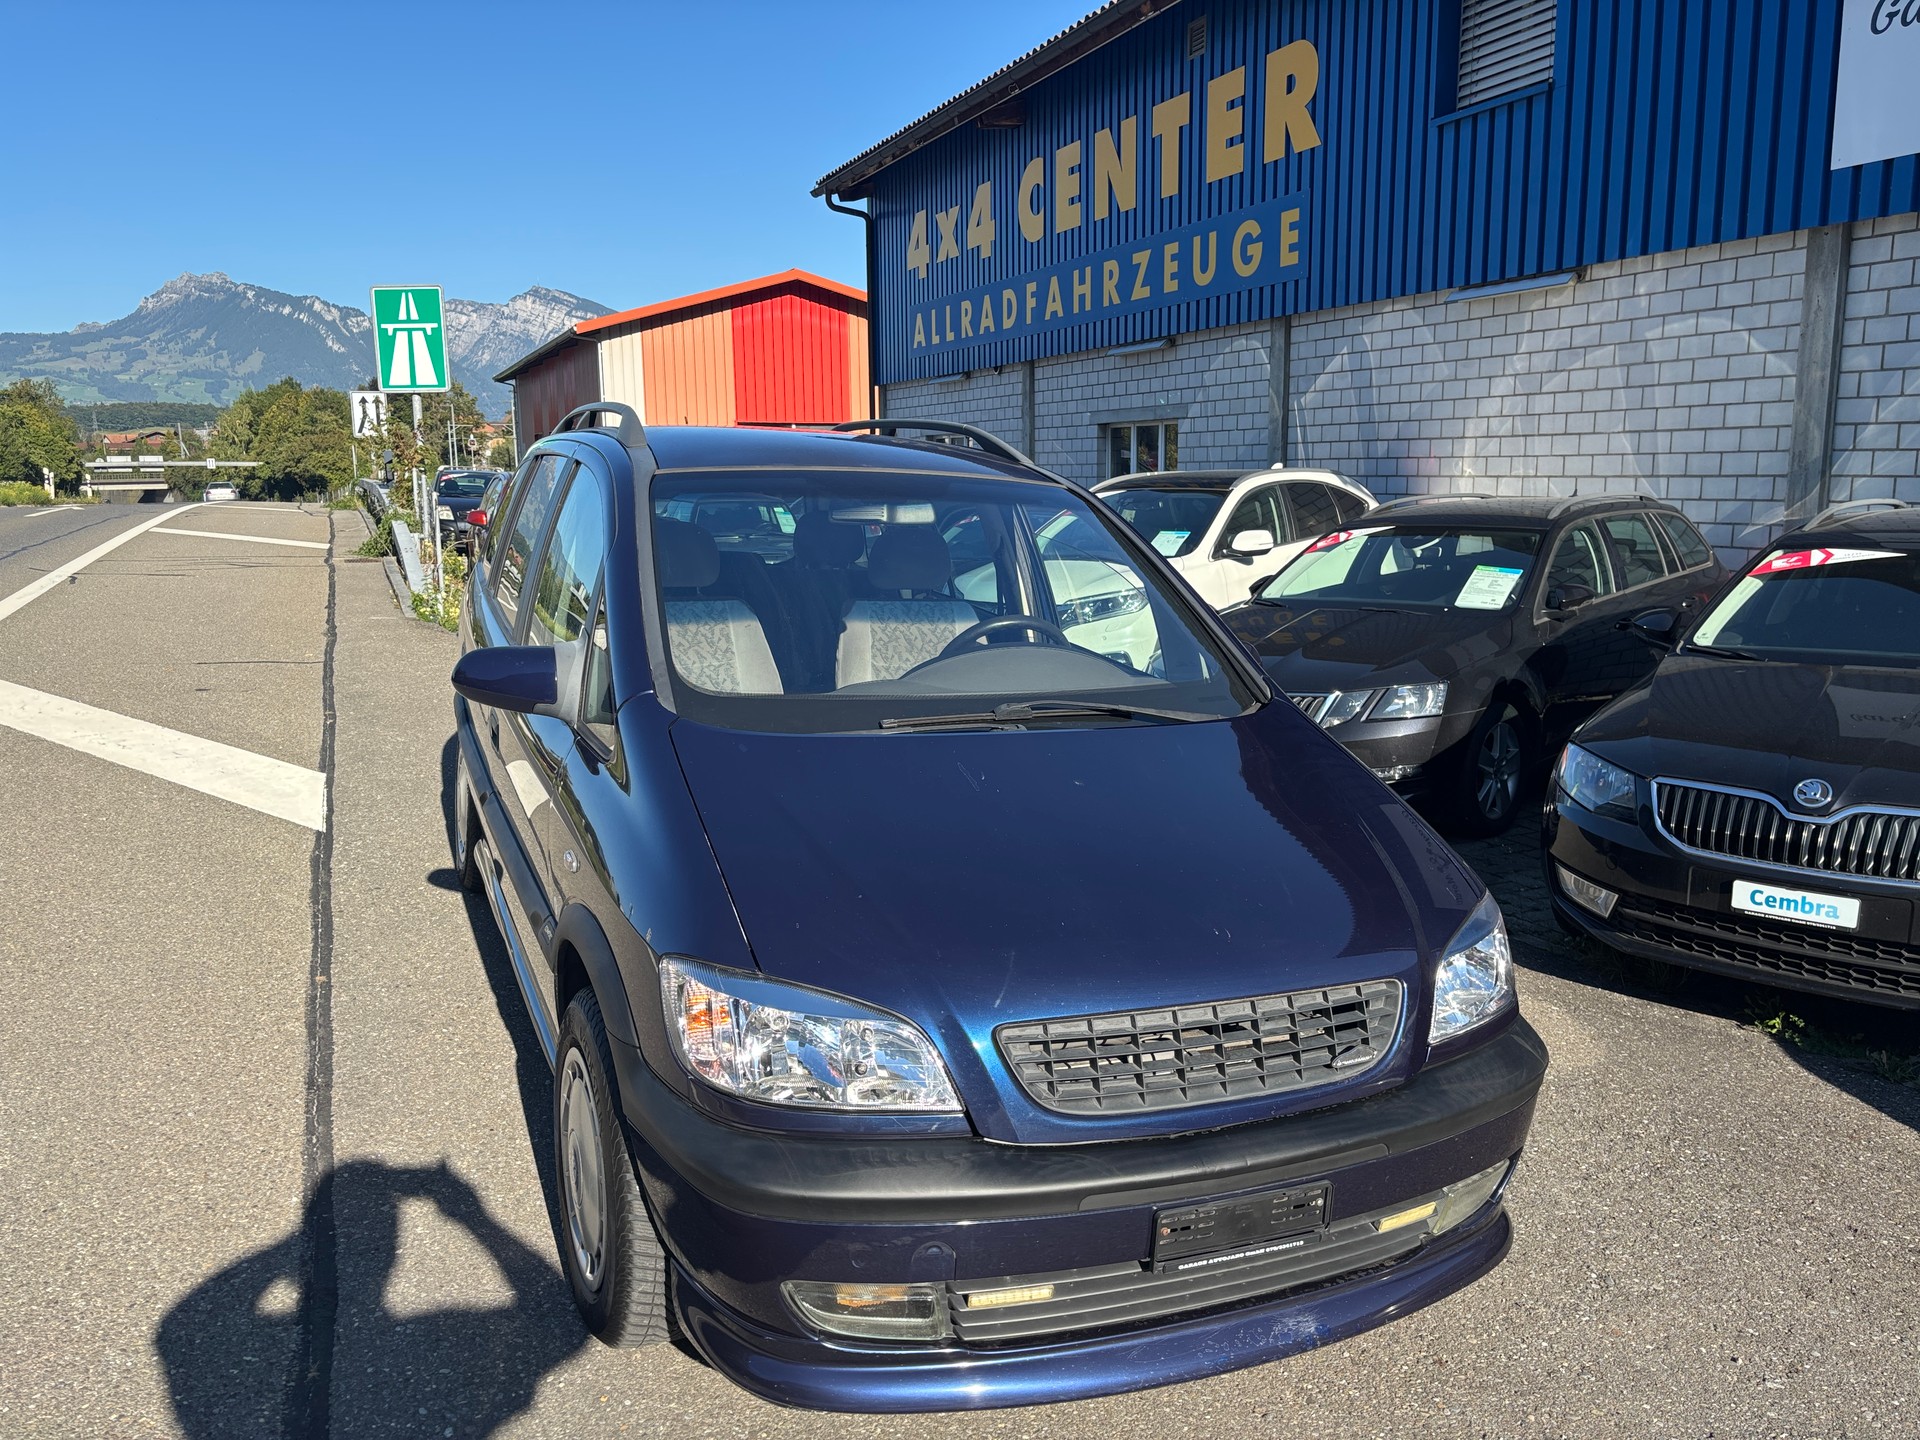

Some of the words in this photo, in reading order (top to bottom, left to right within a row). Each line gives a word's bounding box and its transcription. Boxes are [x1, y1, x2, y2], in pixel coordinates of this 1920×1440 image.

[906, 180, 996, 279] 4x4
[1017, 39, 1322, 243] CENTER
[912, 207, 1300, 350] ALLRADFAHRZEUGE
[1749, 889, 1839, 919] Cembra
[1178, 1260, 1208, 1270] GARAGE
